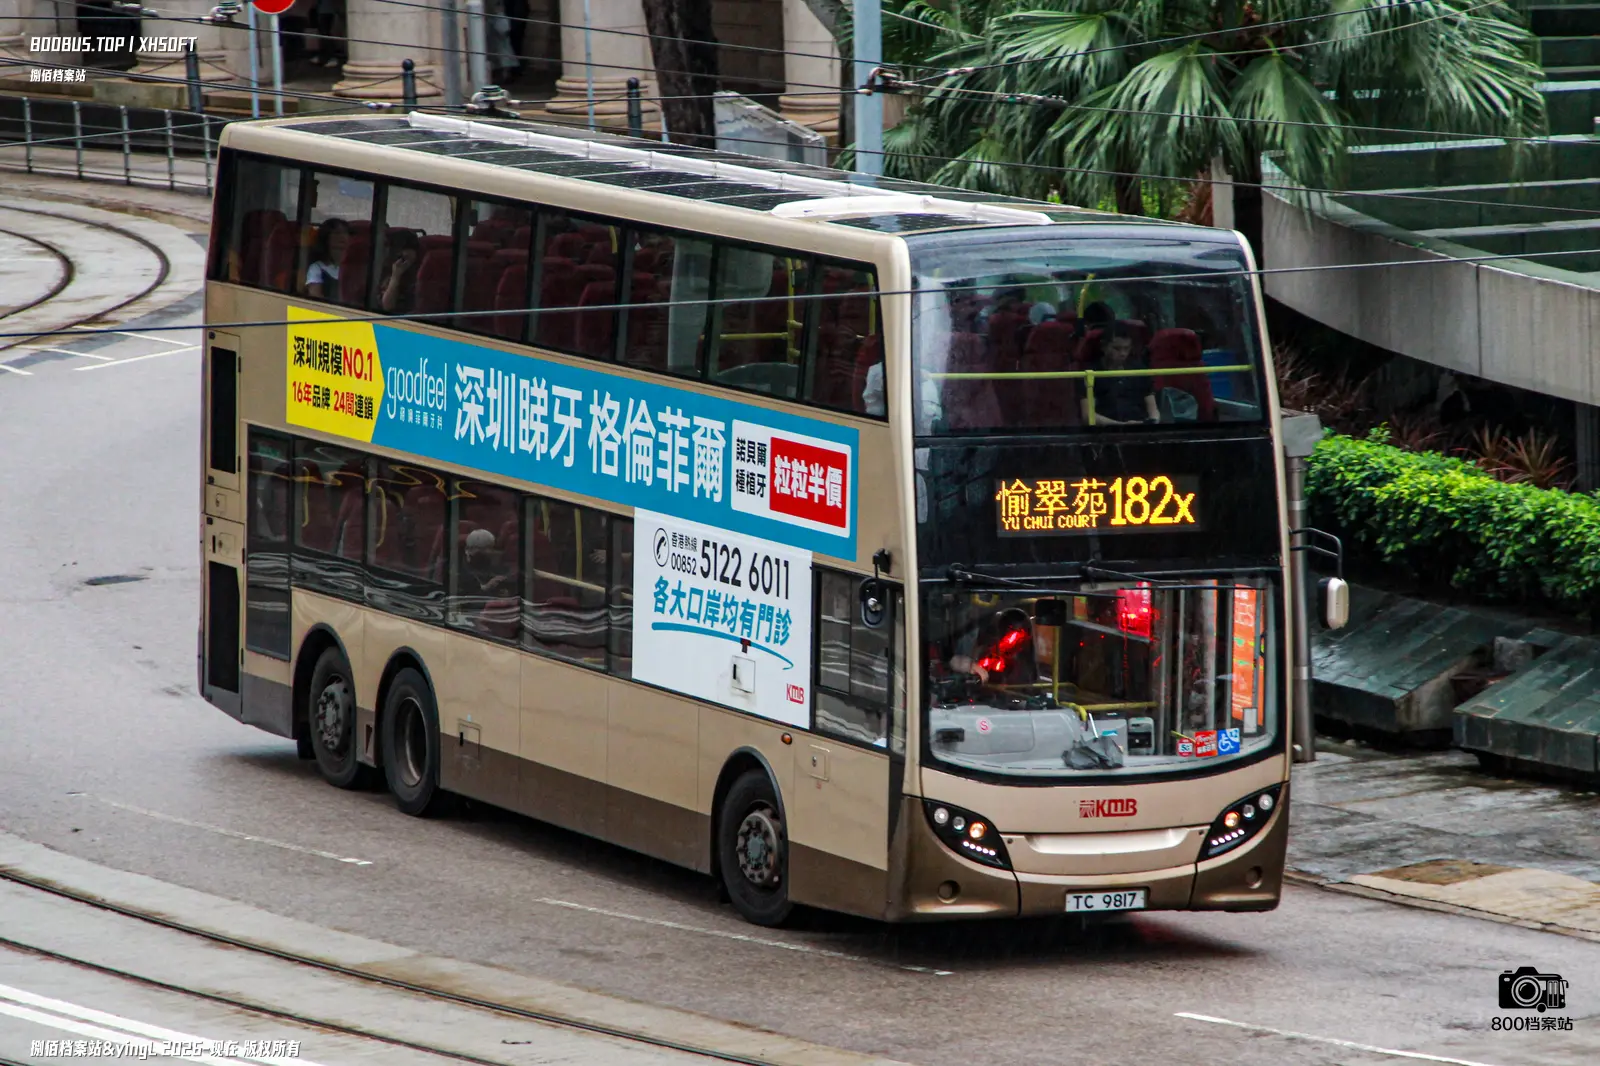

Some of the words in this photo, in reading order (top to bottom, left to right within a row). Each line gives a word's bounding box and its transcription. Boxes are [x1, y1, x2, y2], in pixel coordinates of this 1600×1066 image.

[292, 381, 331, 410] 16年品牌
[387, 357, 447, 419] goodfeel
[454, 362, 583, 468] 深圳睇牙
[588, 389, 726, 503] 格倫菲爾
[774, 454, 843, 509] 粒粒半價
[996, 478, 1107, 517] 愉翠苑
[1002, 516, 1020, 530] YU
[1024, 515, 1054, 529] CHUI
[1058, 514, 1099, 528] COURT
[671, 552, 697, 576] 00852
[700, 539, 742, 588] 5122
[748, 552, 790, 600] 6011
[653, 575, 793, 647] 各大口岸均有門診
[786, 683, 805, 705] KMB
[1096, 798, 1138, 818] KMB
[1073, 895, 1094, 909] TC
[1102, 892, 1137, 909] 9817
